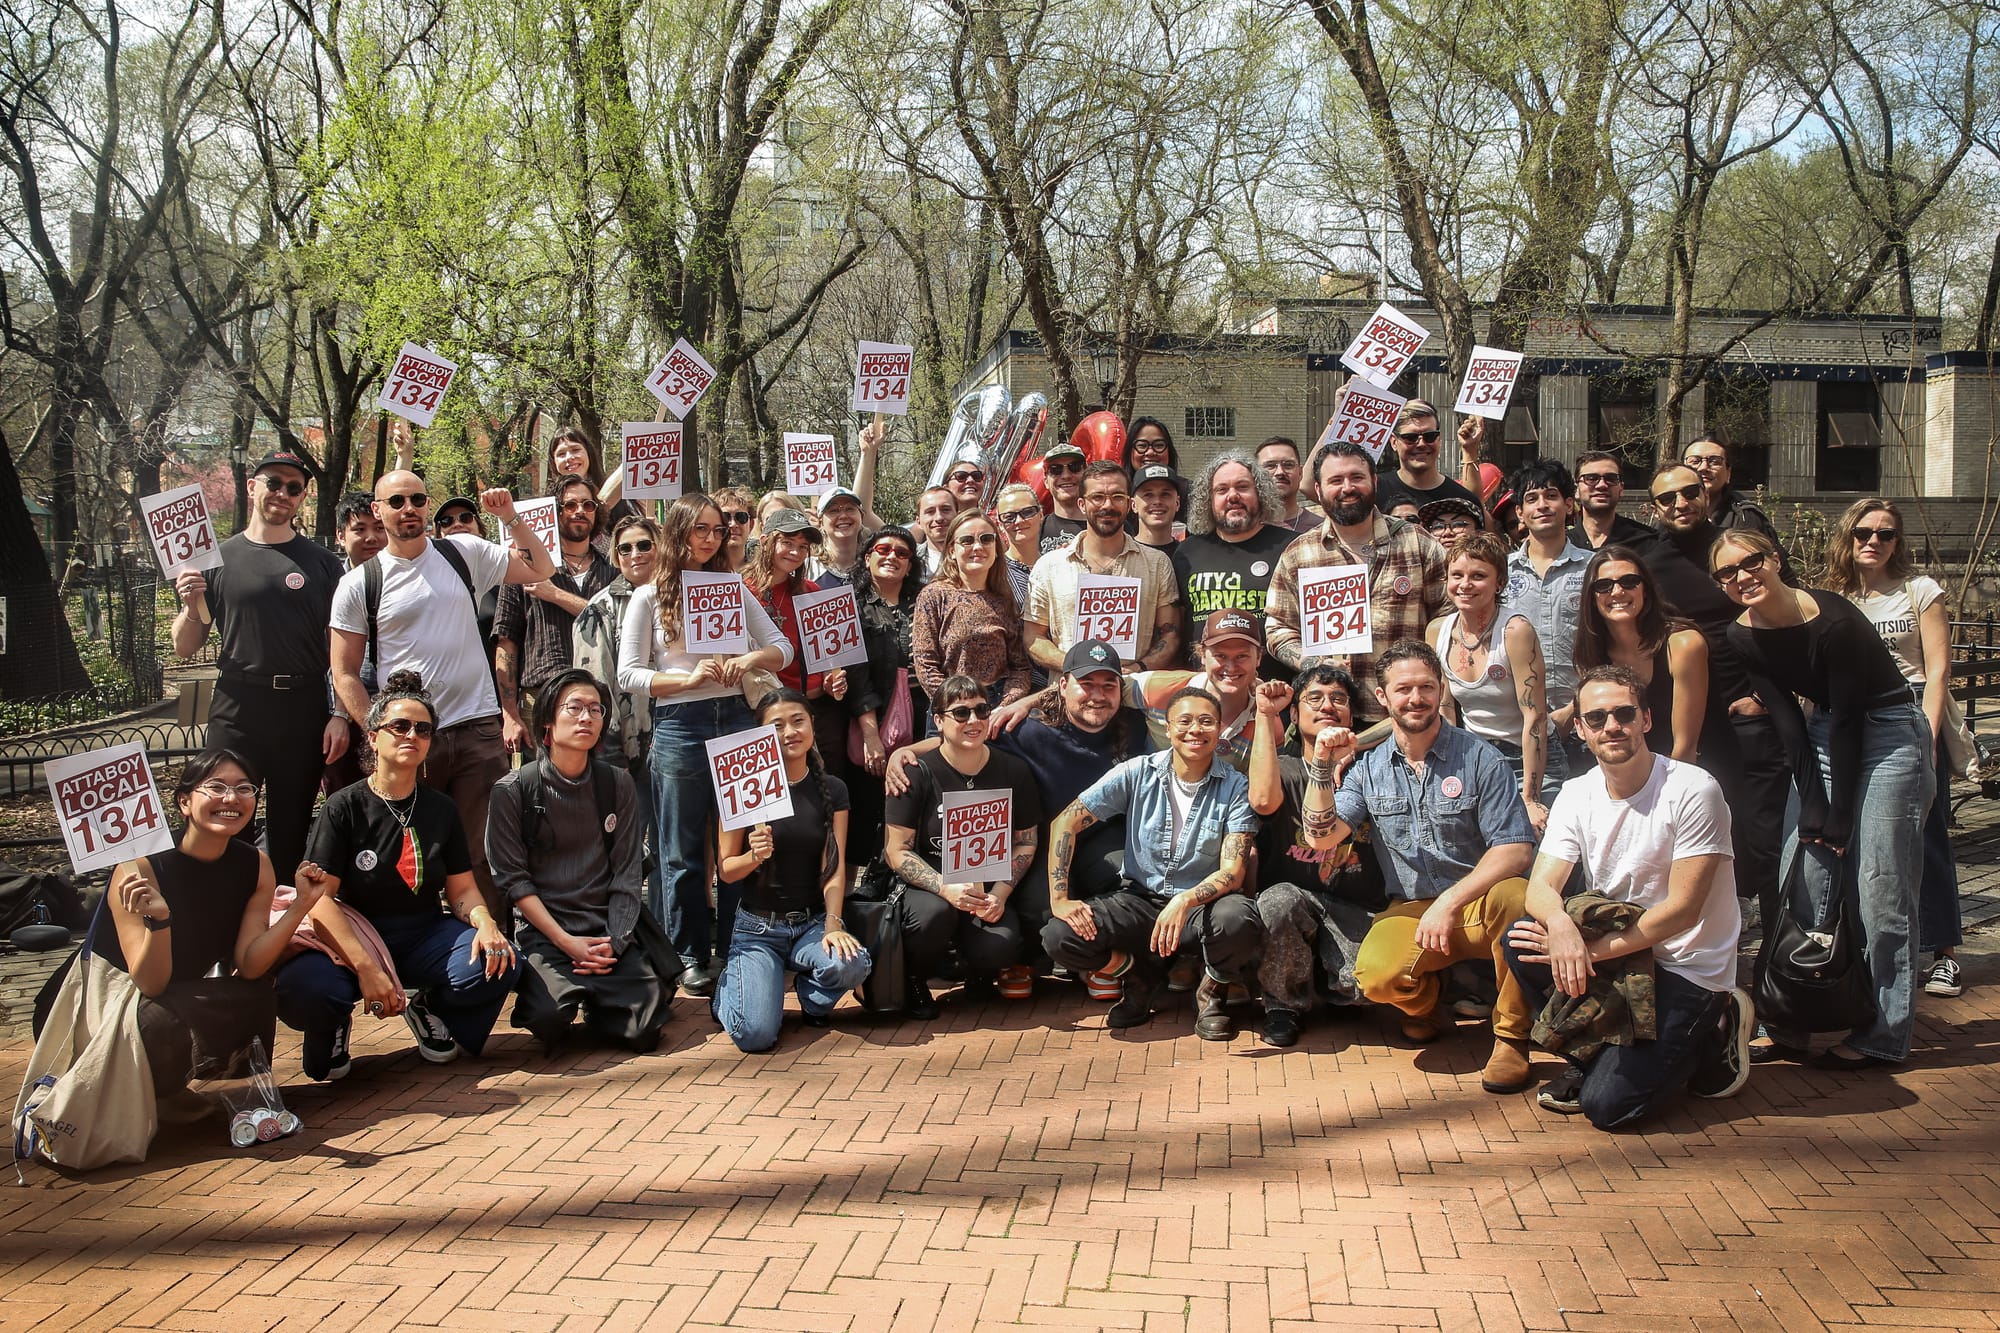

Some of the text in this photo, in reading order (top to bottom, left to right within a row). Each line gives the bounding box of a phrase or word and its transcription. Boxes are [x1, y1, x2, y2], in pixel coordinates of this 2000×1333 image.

[1367, 326, 1410, 356] LOCAL
[1374, 319, 1422, 345] ATTABOY
[402, 358, 451, 377] ATTABOY
[673, 352, 710, 381] ATTABOY
[861, 364, 908, 375] LOCAL
[863, 355, 909, 364] ATTABOY
[1354, 340, 1405, 376] 134
[1473, 360, 1517, 369] ATTABOY
[397, 365, 443, 389] LOCAL
[667, 358, 702, 390] LOCAL
[1470, 369, 1512, 381] LOCAL
[390, 380, 439, 411] 134
[656, 369, 698, 406] 134
[861, 378, 906, 400] 134
[1465, 383, 1509, 404] 134
[1343, 404, 1392, 426] LOCAL
[1349, 394, 1400, 414] ATTABOY
[627, 432, 679, 448] ATTABOY
[1336, 418, 1387, 450] 134
[628, 445, 678, 461] LOCAL
[789, 442, 831, 452] ATTABOY
[790, 451, 832, 463] LOCAL
[628, 459, 678, 487] 134
[791, 463, 833, 485] 134
[151, 494, 199, 524] ATTABOY
[520, 506, 553, 521] ABOY
[154, 508, 205, 539] LOCAL
[505, 516, 554, 538] LCAL
[160, 523, 212, 565] 134
[689, 584, 739, 597] ATTABOY
[1082, 588, 1136, 599] ATTABOY
[1188, 572, 1226, 592] CITY
[1306, 576, 1364, 597] ATTABOY
[690, 595, 740, 612] LOCAL
[802, 595, 851, 620] ATTABOY
[1081, 600, 1135, 613] LOCAL
[1307, 589, 1365, 612] LOCAL
[692, 611, 742, 640] 134
[805, 607, 854, 633] LOCAL
[1080, 616, 1133, 642] 134
[1307, 607, 1366, 642] 134
[808, 622, 859, 660] 134
[718, 737, 773, 769] ATTABOY
[61, 756, 140, 798] ATTABOY
[720, 752, 778, 784] LOCAL
[65, 774, 148, 817] LOCAL
[724, 769, 783, 815] 134
[949, 800, 1007, 822] ATTABOY
[73, 794, 158, 853] 134
[949, 814, 1007, 838] LOCAL
[950, 832, 1006, 870] 134
